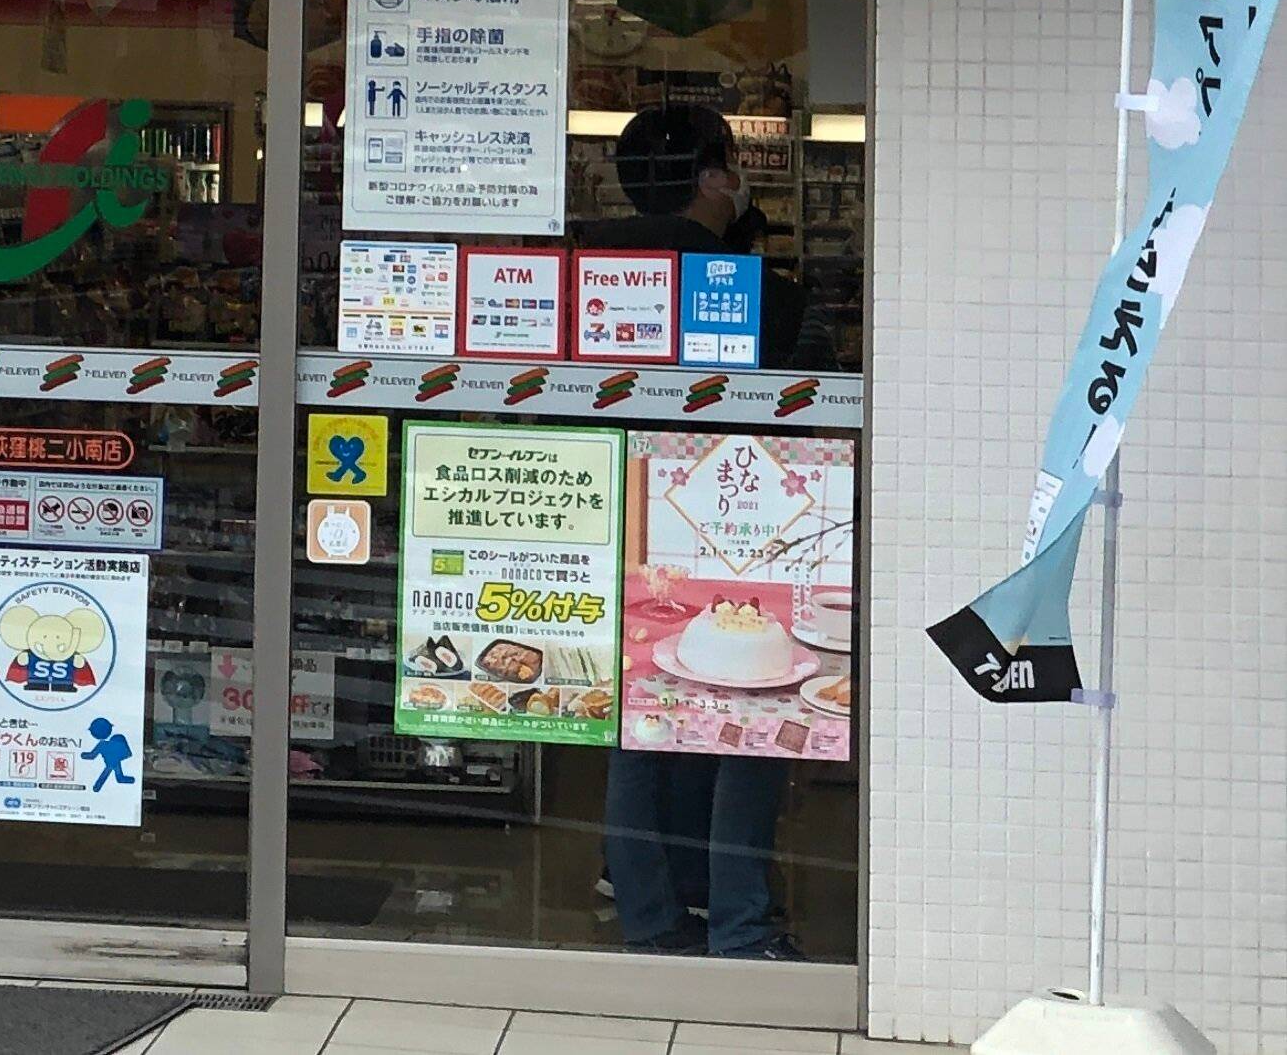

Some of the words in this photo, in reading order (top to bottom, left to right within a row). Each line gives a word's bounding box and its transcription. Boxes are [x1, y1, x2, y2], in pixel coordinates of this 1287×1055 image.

[415, 27, 505, 45] 手指の除菌
[416, 80, 549, 96] ソーシャルディスタンス
[415, 130, 531, 146] キャッシュレス決済
[493, 268, 533, 284] ATM
[583, 270, 619, 287] Free
[623, 271, 667, 287] Wi-Fi
[698, 301, 742, 312] クーポン
[435, 464, 593, 487] 食品ロス削減のため
[734, 444, 760, 493] ひな
[717, 458, 739, 517] まつり
[423, 486, 604, 510] エシカルプロジェクトを
[736, 500, 759, 511] 2021
[447, 508, 575, 530] 推進しています。
[699, 522, 781, 537] ご予約承り中!
[468, 549, 590, 566] このシールがついた商品を
[14, 586, 49, 606] SAFETY
[52, 586, 91, 607] STATION
[412, 589, 474, 610] nanaco
[476, 581, 605, 625] 5%付与
[33, 661, 68, 678] SS
[12, 752, 35, 764] 119
